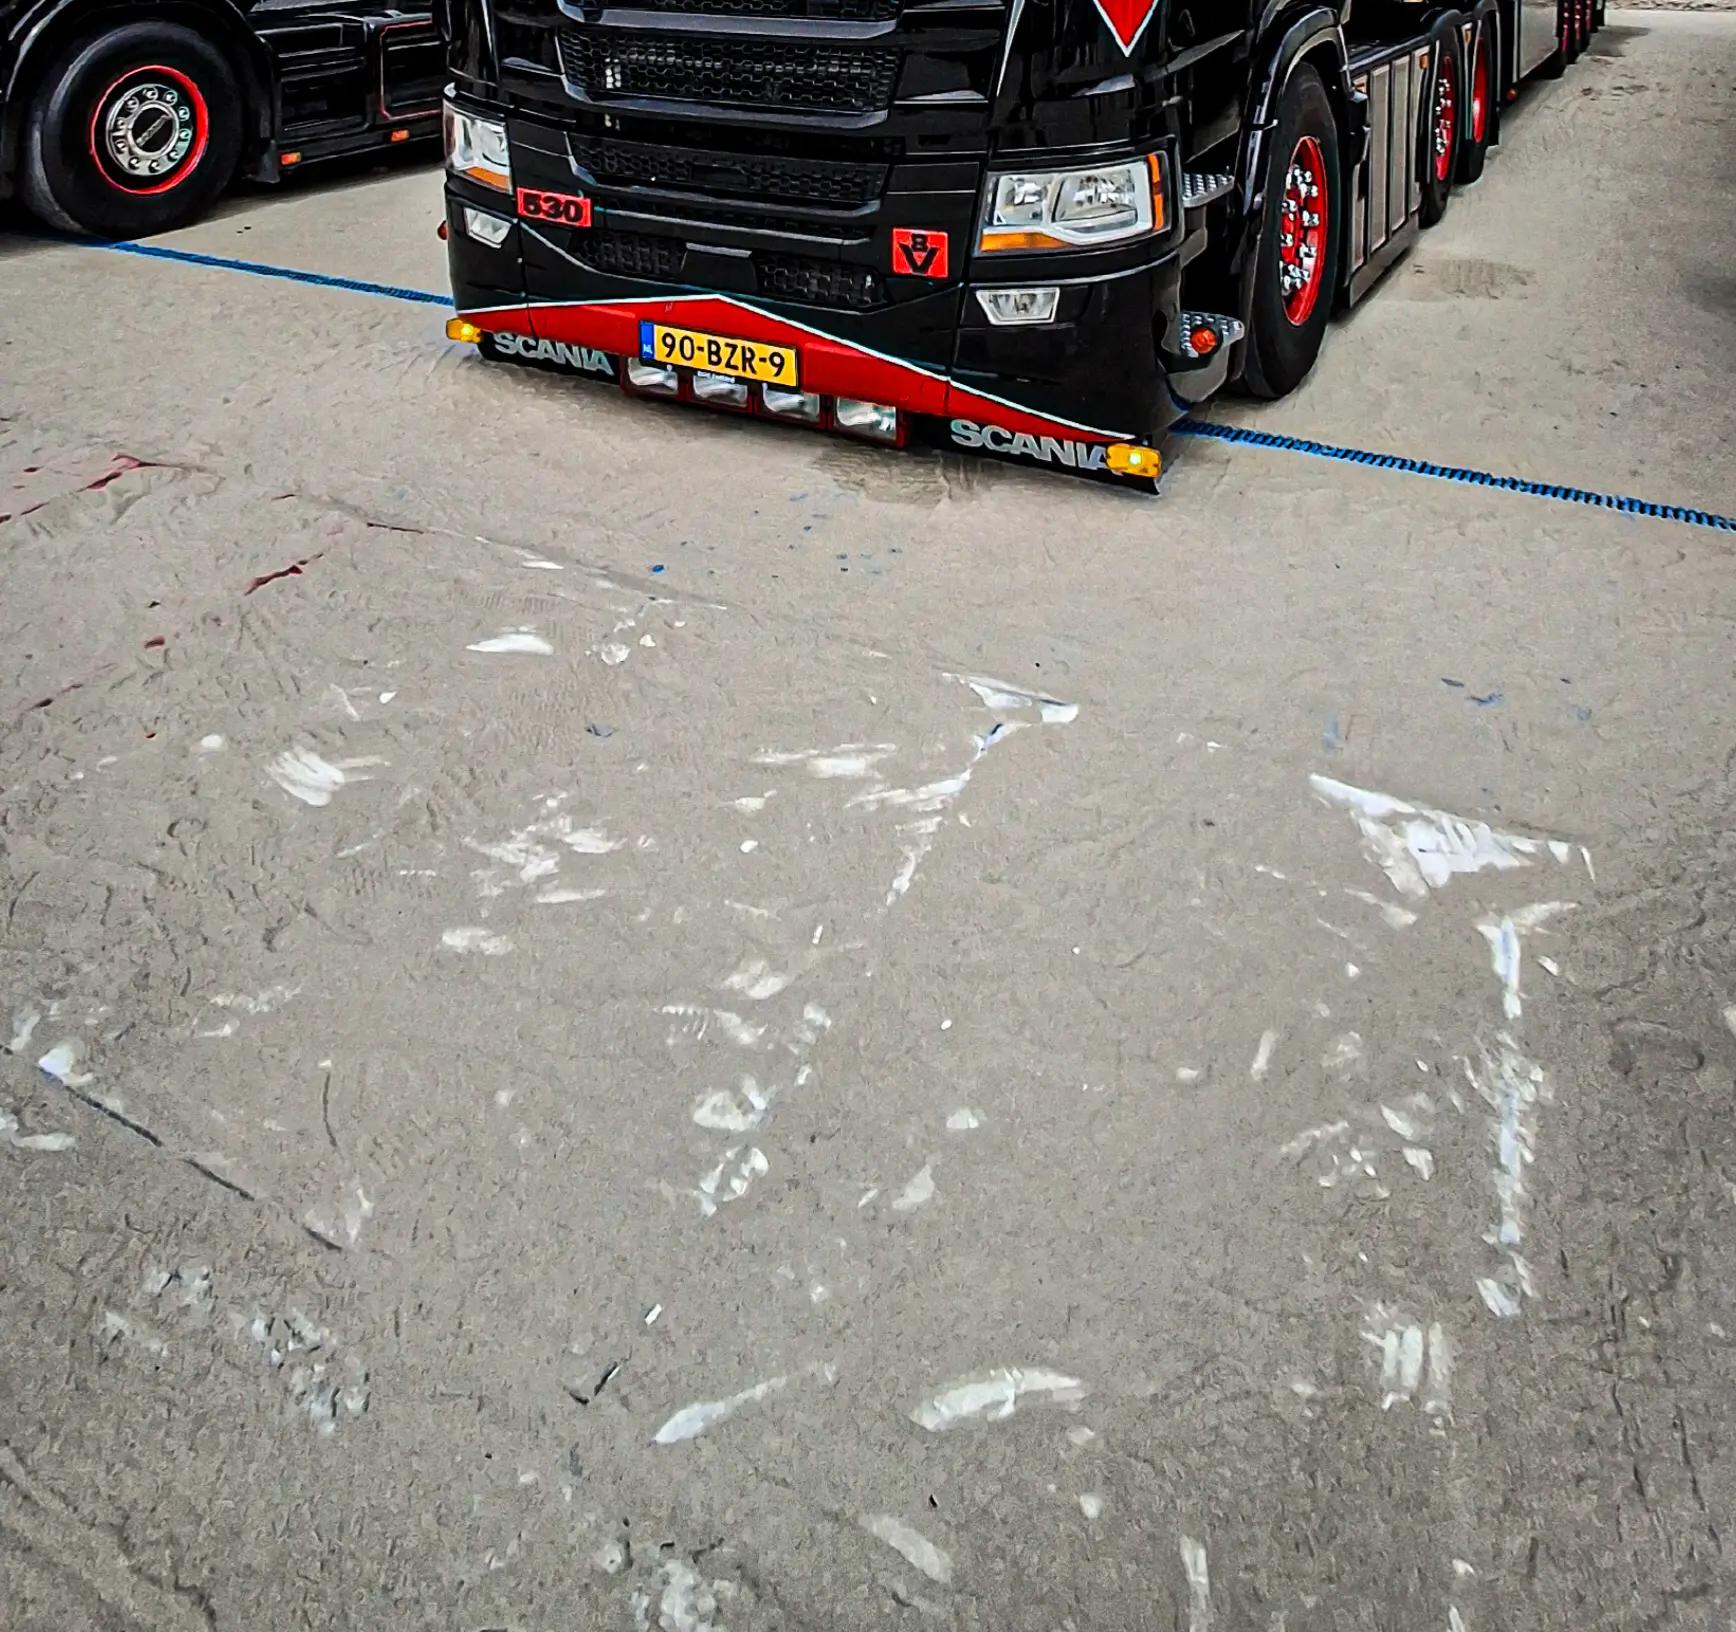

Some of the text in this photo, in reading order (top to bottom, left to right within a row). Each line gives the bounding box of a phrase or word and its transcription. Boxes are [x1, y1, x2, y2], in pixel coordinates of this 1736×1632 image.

[522, 192, 584, 222] 530
[493, 331, 615, 377] SCANIA
[661, 332, 785, 377] 90-BZR-9
